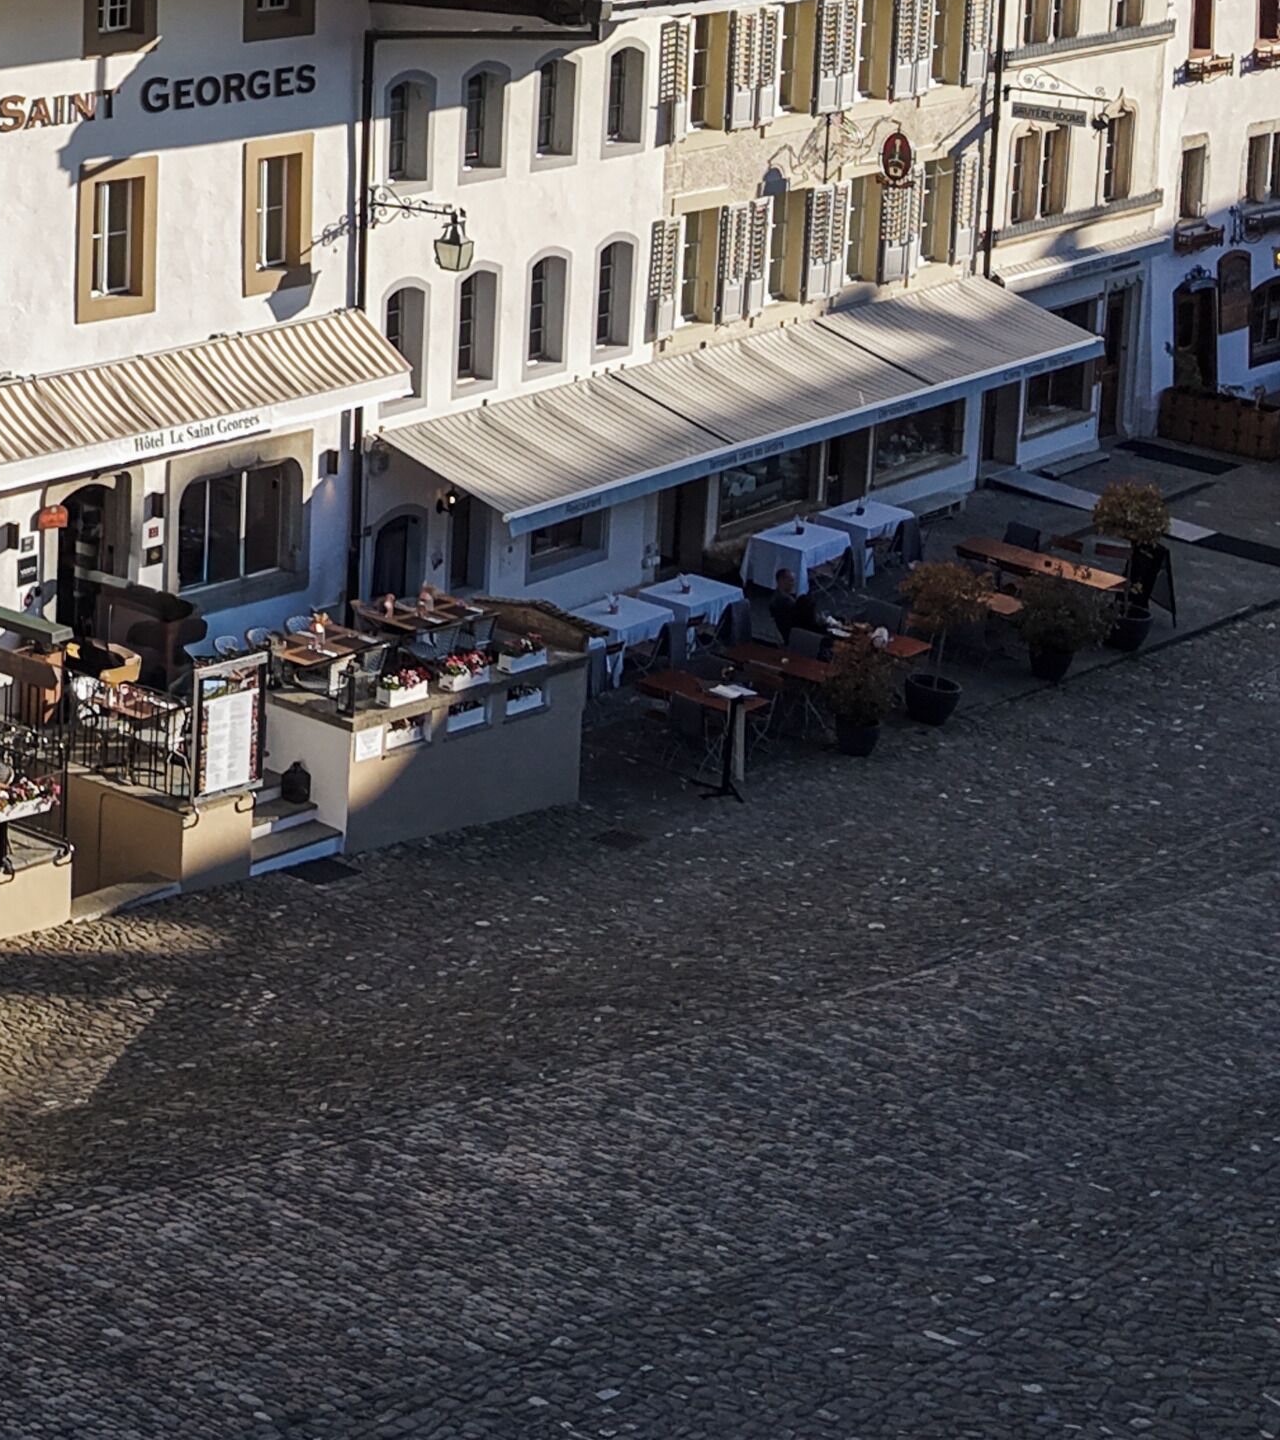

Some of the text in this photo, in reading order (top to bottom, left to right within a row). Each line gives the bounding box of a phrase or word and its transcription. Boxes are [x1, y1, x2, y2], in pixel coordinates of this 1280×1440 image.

[141, 64, 317, 113] GEORGES
[134, 413, 260, 453] Hôtel Le Saint Georges
